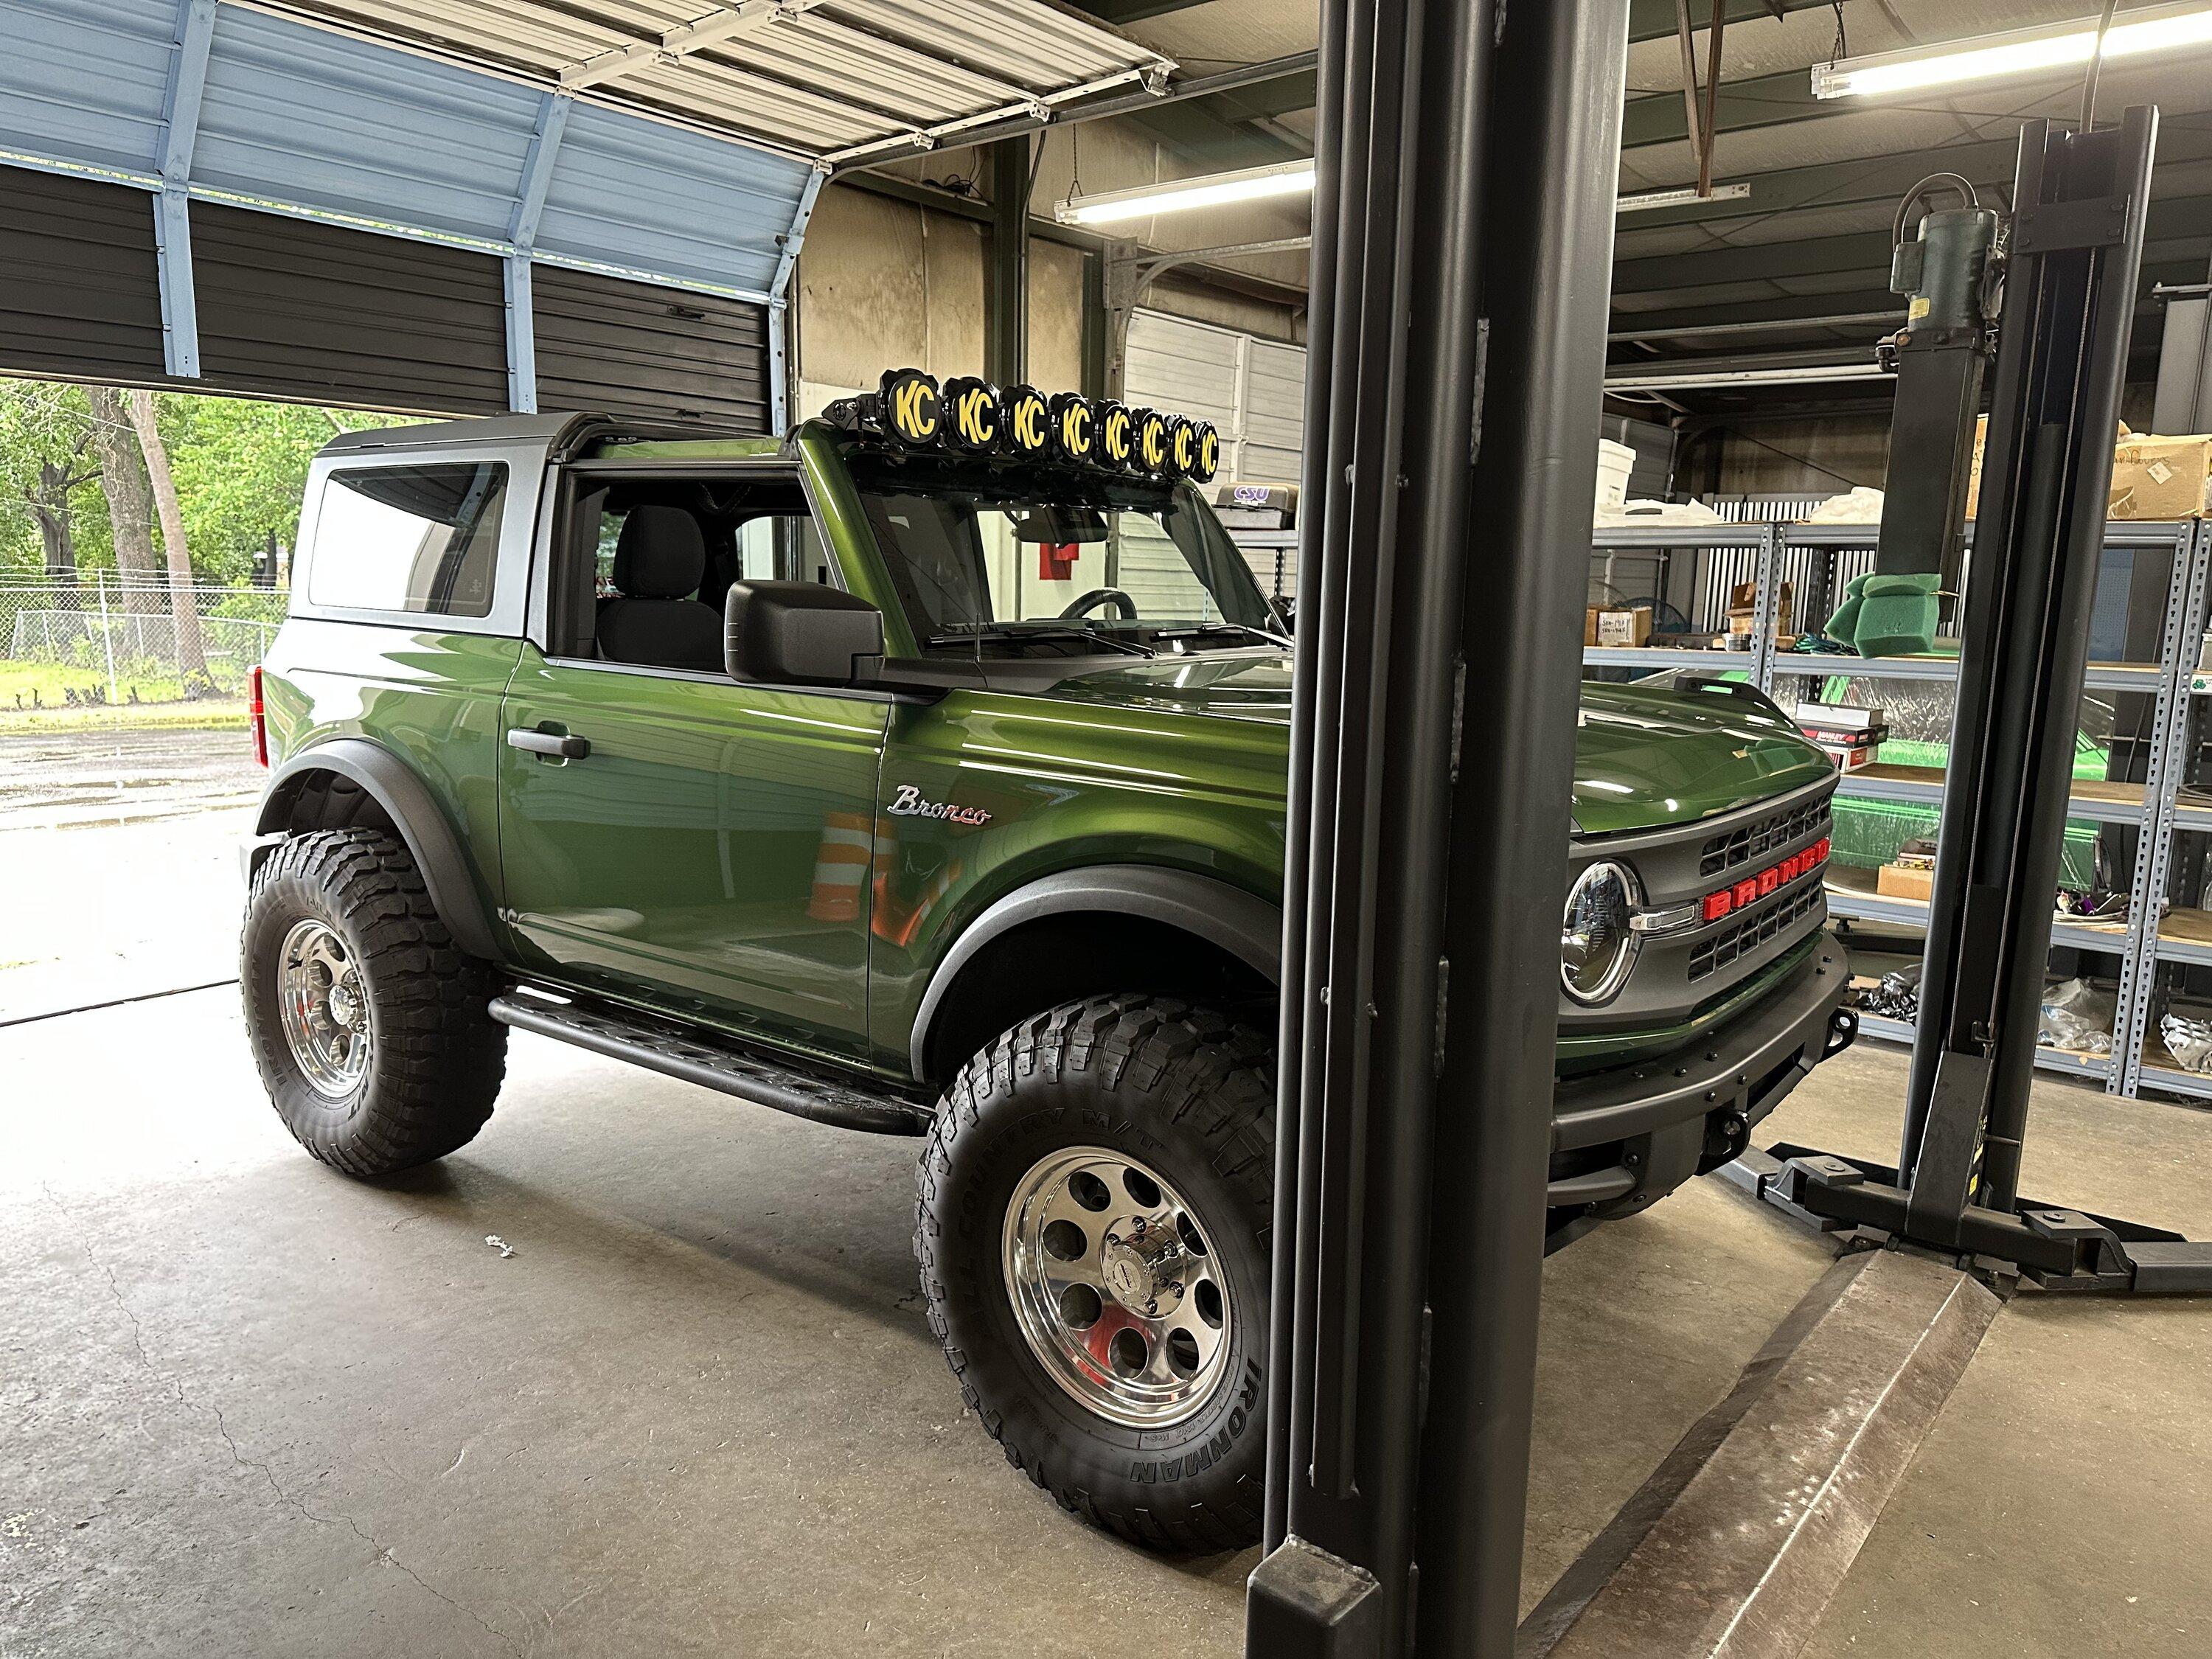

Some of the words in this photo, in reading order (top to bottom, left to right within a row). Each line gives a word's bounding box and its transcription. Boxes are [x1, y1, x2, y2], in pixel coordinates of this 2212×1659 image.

[896, 380, 935, 438] KC
[959, 388, 993, 444] KC
[1015, 395, 1045, 450] KC
[1063, 403, 1090, 455] KC
[1106, 411, 1130, 461] KC
[1143, 417, 1164, 466] KC
[1174, 424, 1193, 470] KC
[1201, 430, 1217, 475] KC
[1235, 486, 1269, 501] CSU
[887, 785, 992, 825] Bronco
[1703, 837, 1830, 921] BRONCO
[1130, 1354, 1262, 1484] IRONMAN
